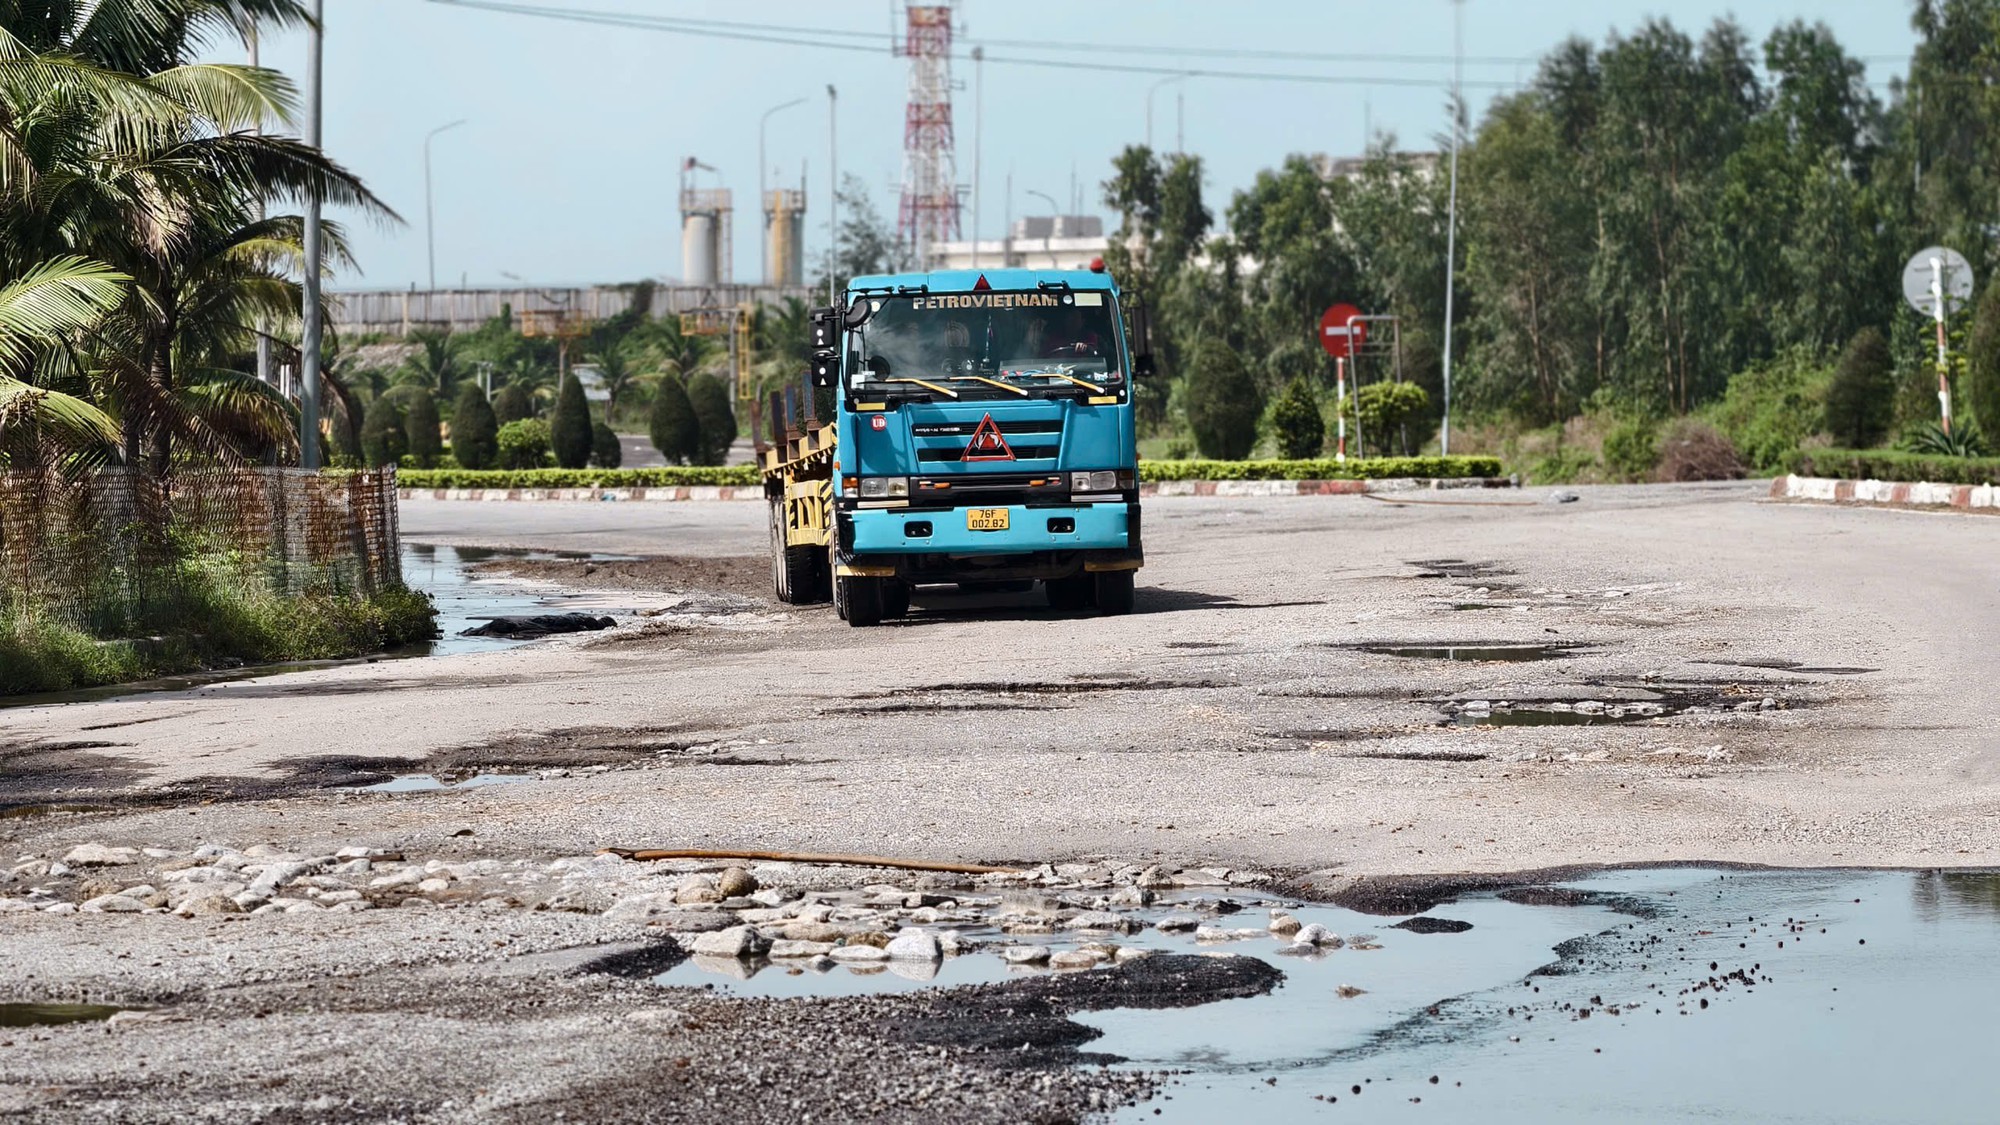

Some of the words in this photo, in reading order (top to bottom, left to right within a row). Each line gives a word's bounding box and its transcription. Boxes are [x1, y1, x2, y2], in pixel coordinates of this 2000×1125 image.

[913, 293, 1058, 310] PETROVIETNAM
[872, 417, 886, 428] UD
[979, 509, 996, 518] 76F
[972, 519, 1005, 528] 002.82
